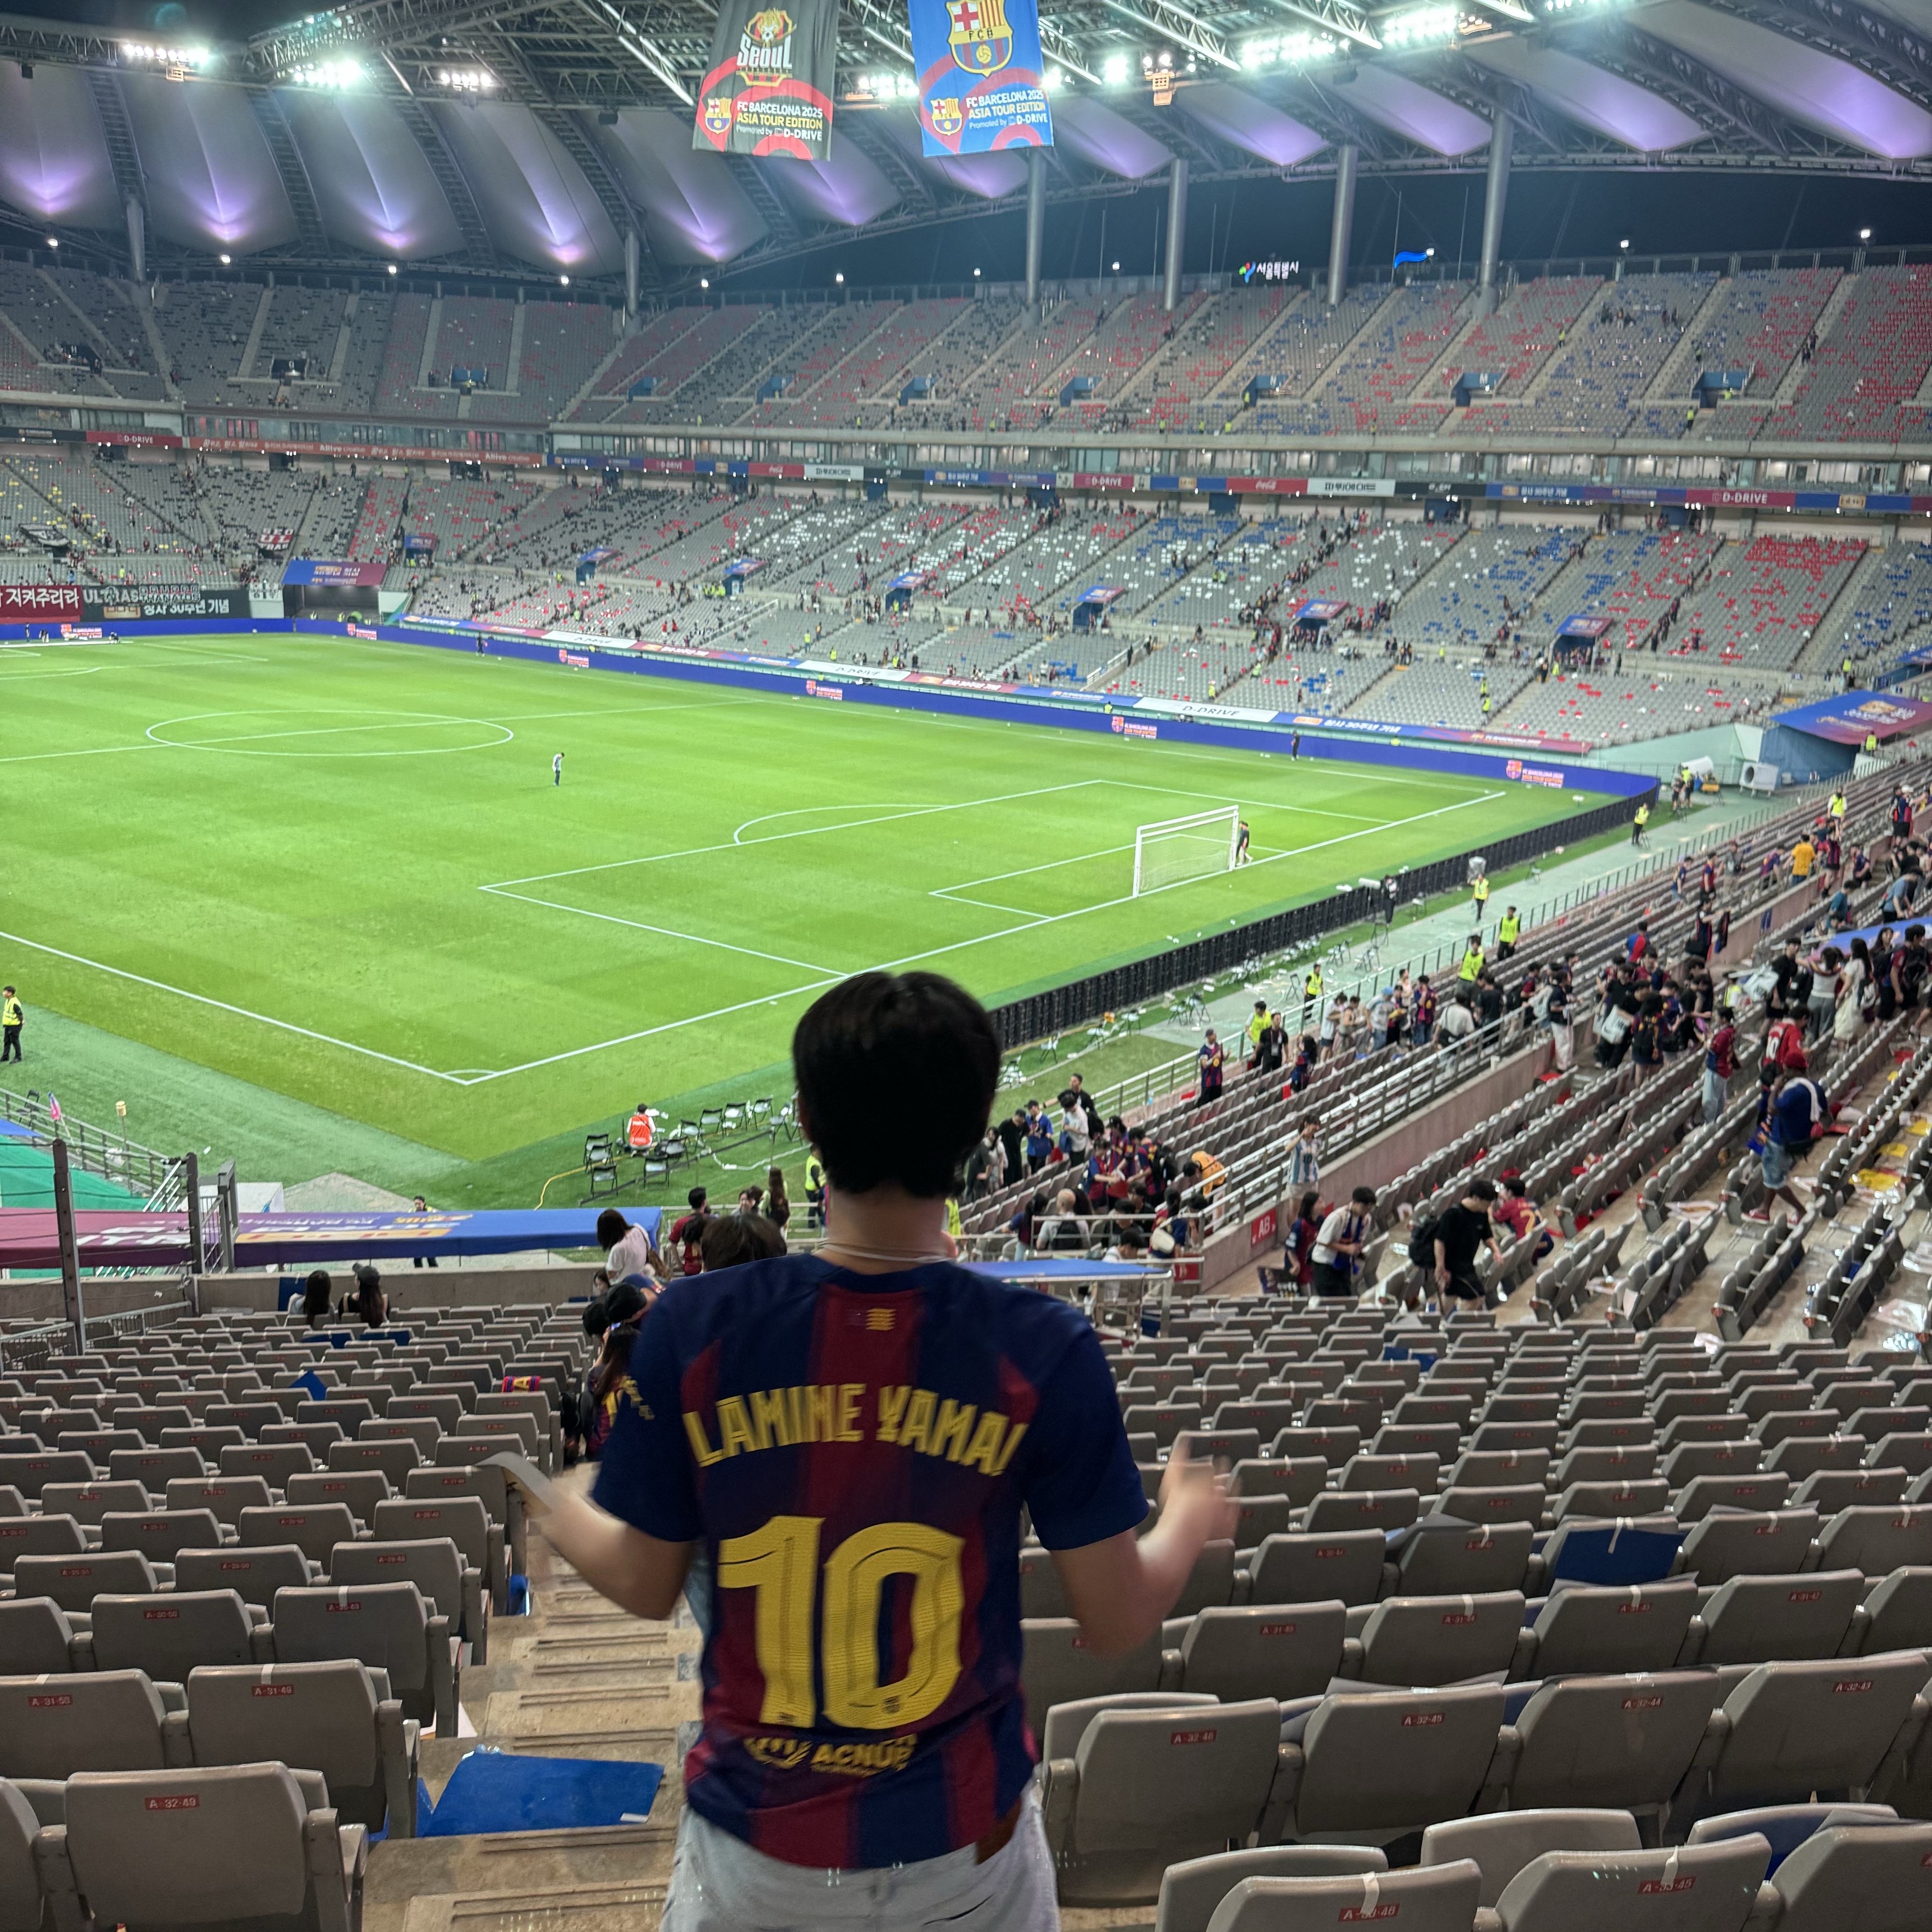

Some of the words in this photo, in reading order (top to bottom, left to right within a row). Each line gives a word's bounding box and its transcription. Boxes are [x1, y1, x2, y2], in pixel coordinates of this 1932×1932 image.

[737, 33, 792, 69] Seoul
[966, 97, 978, 108] FC
[979, 90, 1027, 106] BARCELONA
[1027, 89, 1044, 100] 2025
[737, 101, 748, 112] FC
[749, 102, 801, 116] BARCELONA
[801, 106, 823, 118] 2025
[969, 109, 992, 120] ASIA
[992, 104, 1017, 116] TOUR
[1016, 101, 1045, 113] EDITION
[737, 112, 759, 125] ASIA
[759, 115, 785, 127] TOUR
[785, 117, 823, 129] EDITION
[970, 119, 998, 129] Promoted
[999, 118, 1007, 126] by
[1016, 113, 1048, 125] D-DRIVE
[783, 128, 823, 141] D-DRIVE
[1256, 261, 1299, 280] 서울특별시
[124, 435, 153, 444] D-DRIVE
[1722, 492, 1767, 504] D-DRIVE
[5, 587, 80, 610] 지켜주리라
[207, 598, 230, 614] 기념
[1182, 705, 1240, 716] D-DRIVE
[1766, 1036, 1779, 1061] 10
[1258, 1215, 1270, 1238] AB
[682, 1383, 867, 1468] LAMINE
[718, 1515, 966, 1730] 10
